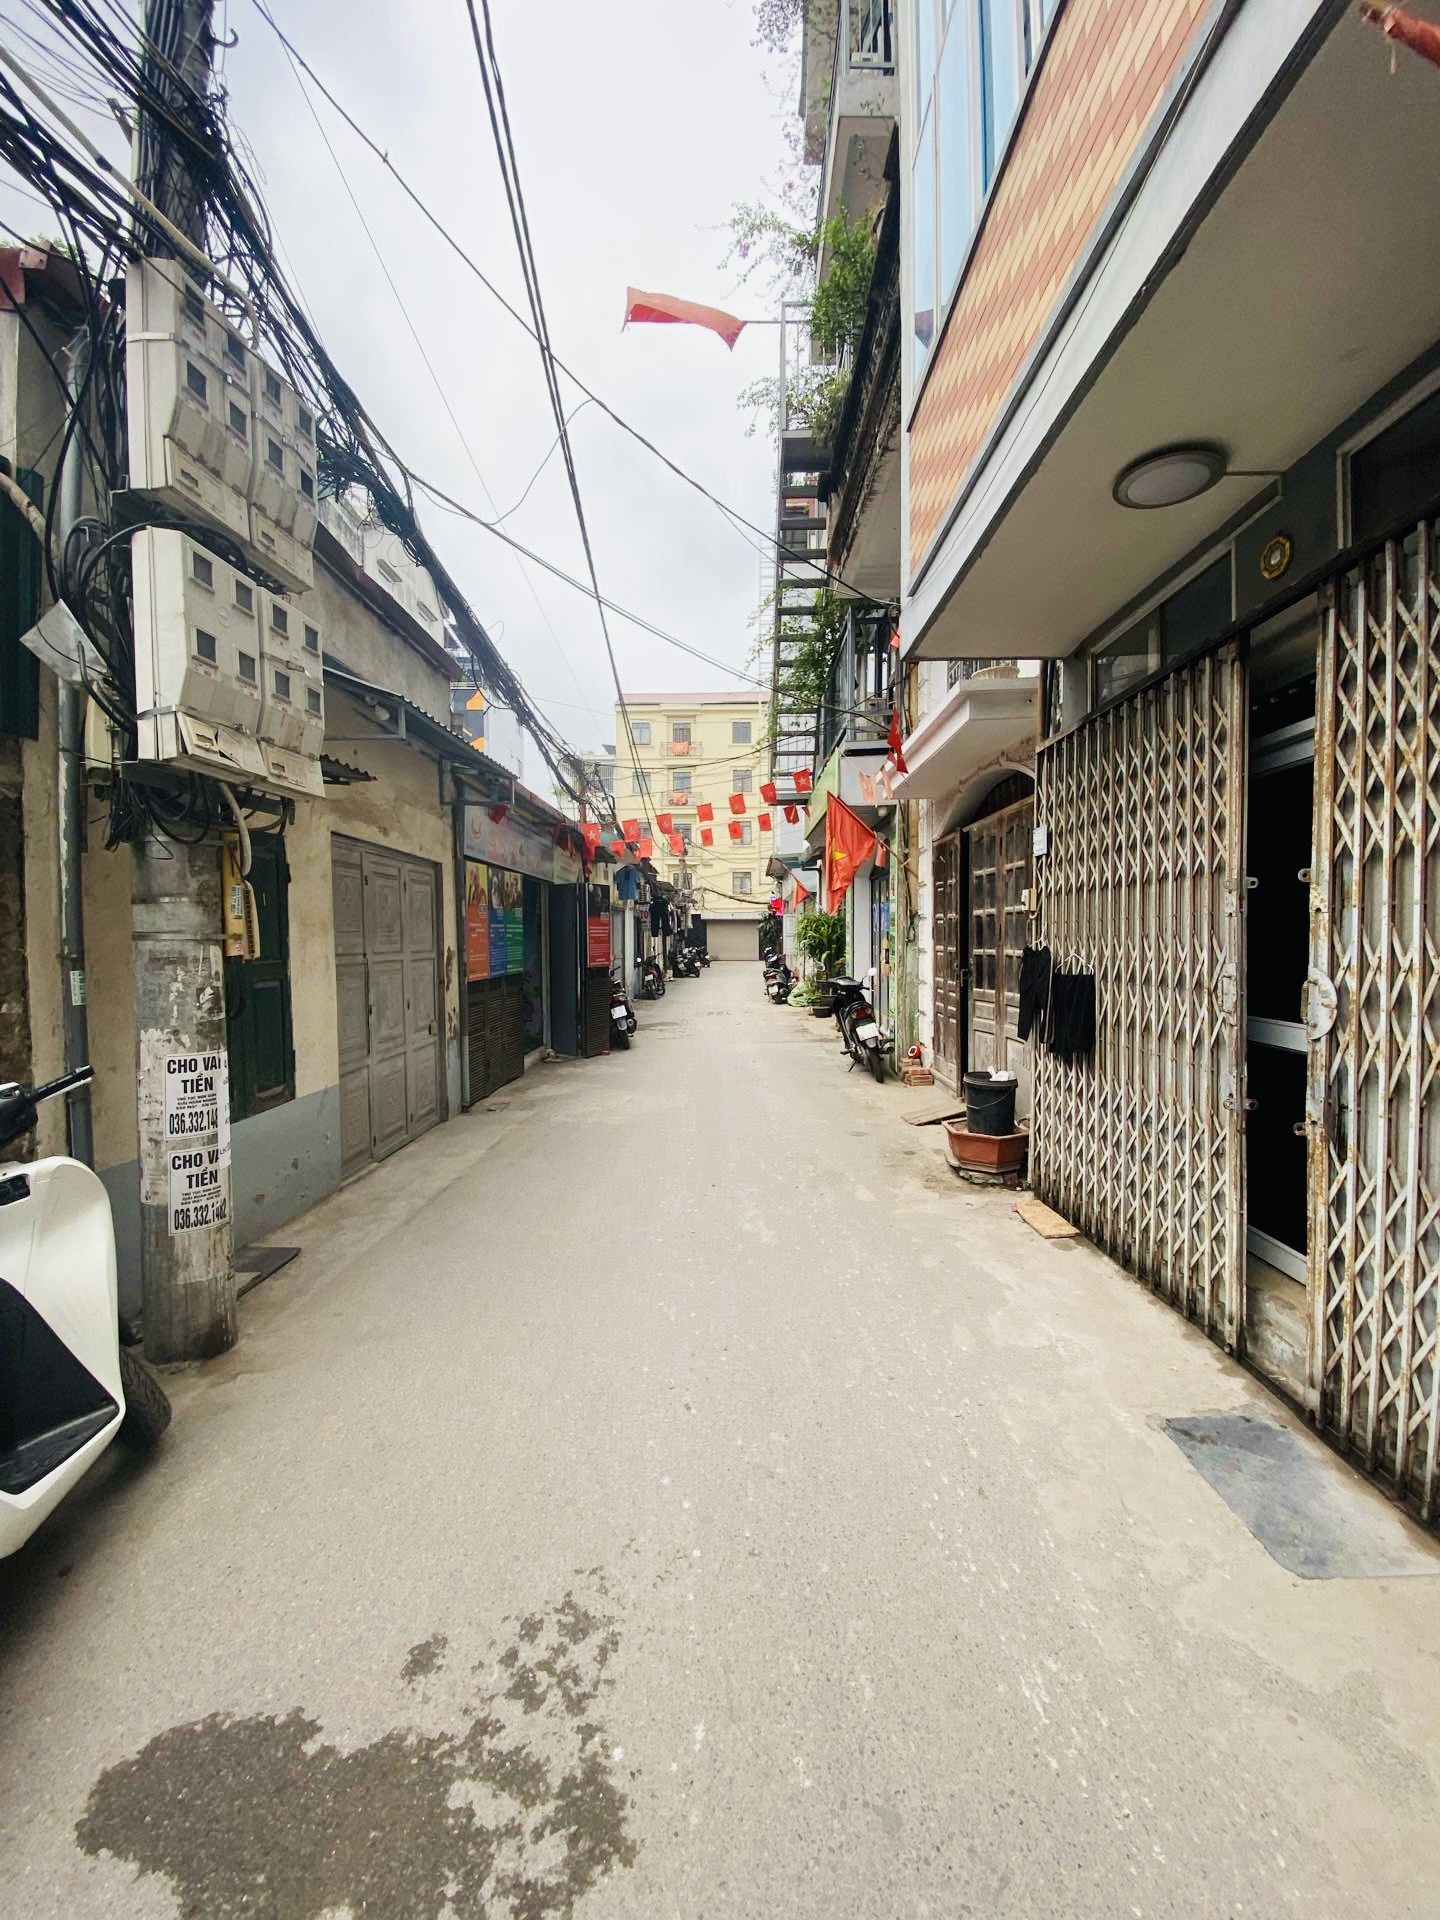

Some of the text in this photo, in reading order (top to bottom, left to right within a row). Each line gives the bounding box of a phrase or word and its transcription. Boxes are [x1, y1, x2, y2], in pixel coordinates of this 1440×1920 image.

[167, 1058, 198, 1074] CHO
[181, 1073, 213, 1094] TIỀN
[172, 1152, 203, 1170] CHO
[186, 1167, 218, 1189] TIỀN
